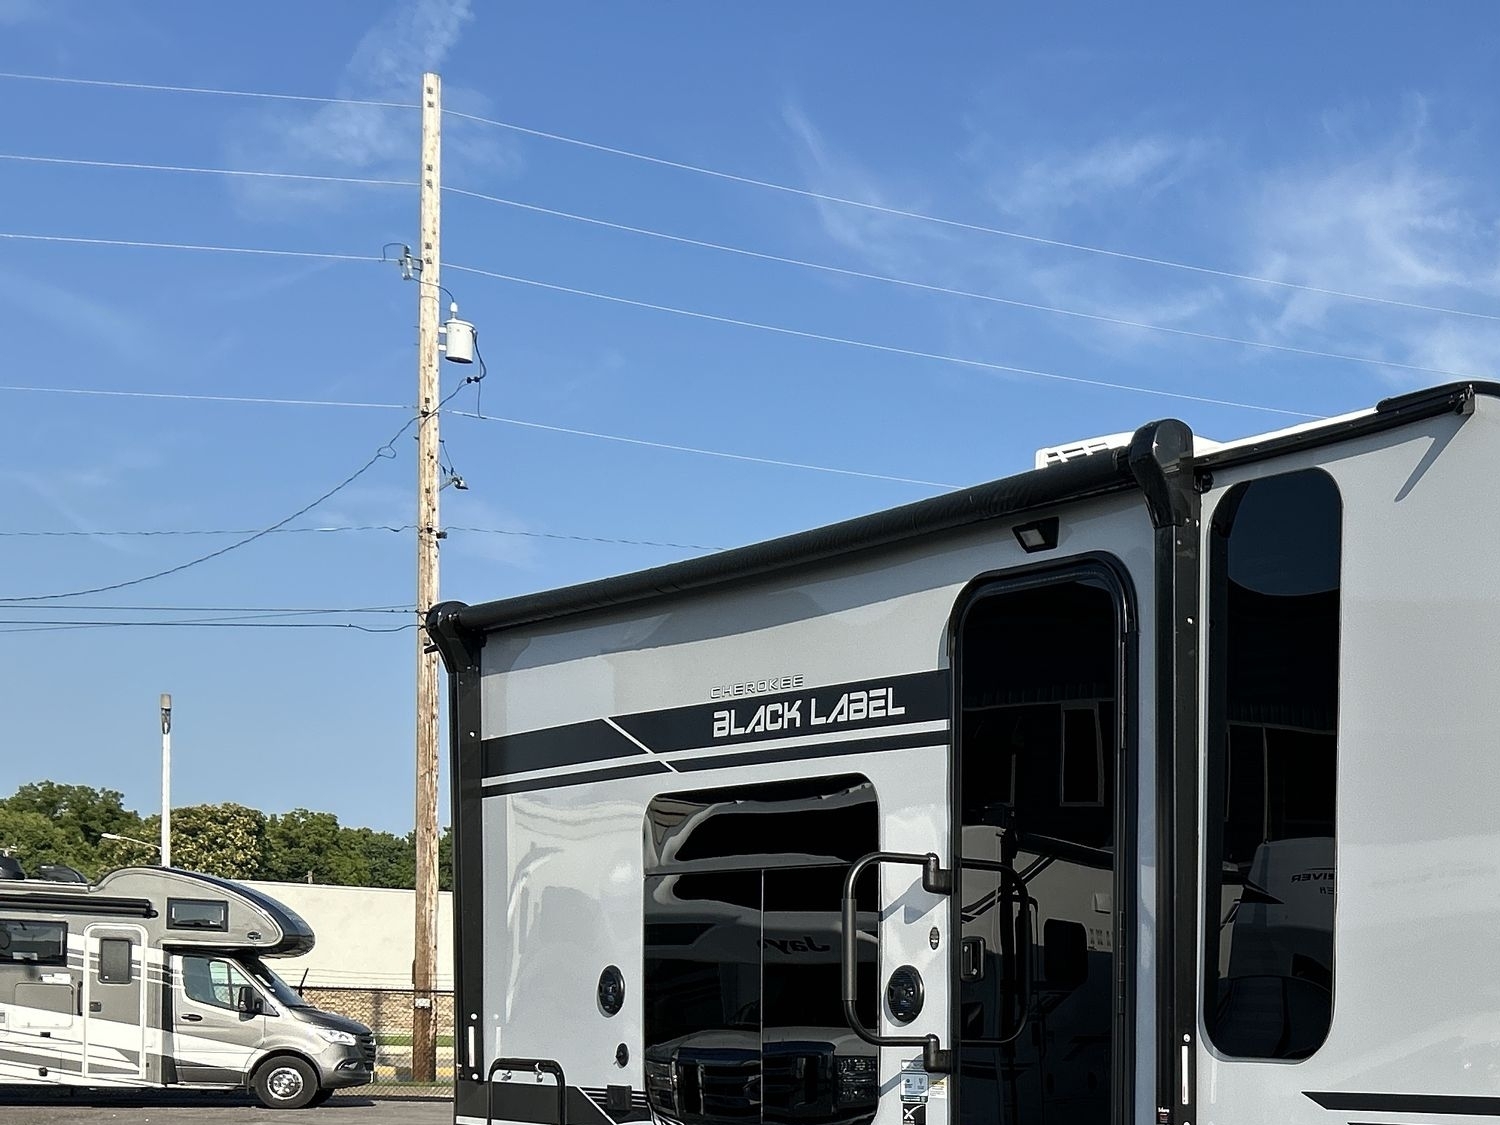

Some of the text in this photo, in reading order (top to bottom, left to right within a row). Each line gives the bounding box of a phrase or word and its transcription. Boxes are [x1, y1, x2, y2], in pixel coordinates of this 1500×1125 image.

[709, 674, 804, 700] CHEROKEE
[713, 687, 906, 738] BLACK LABEL
